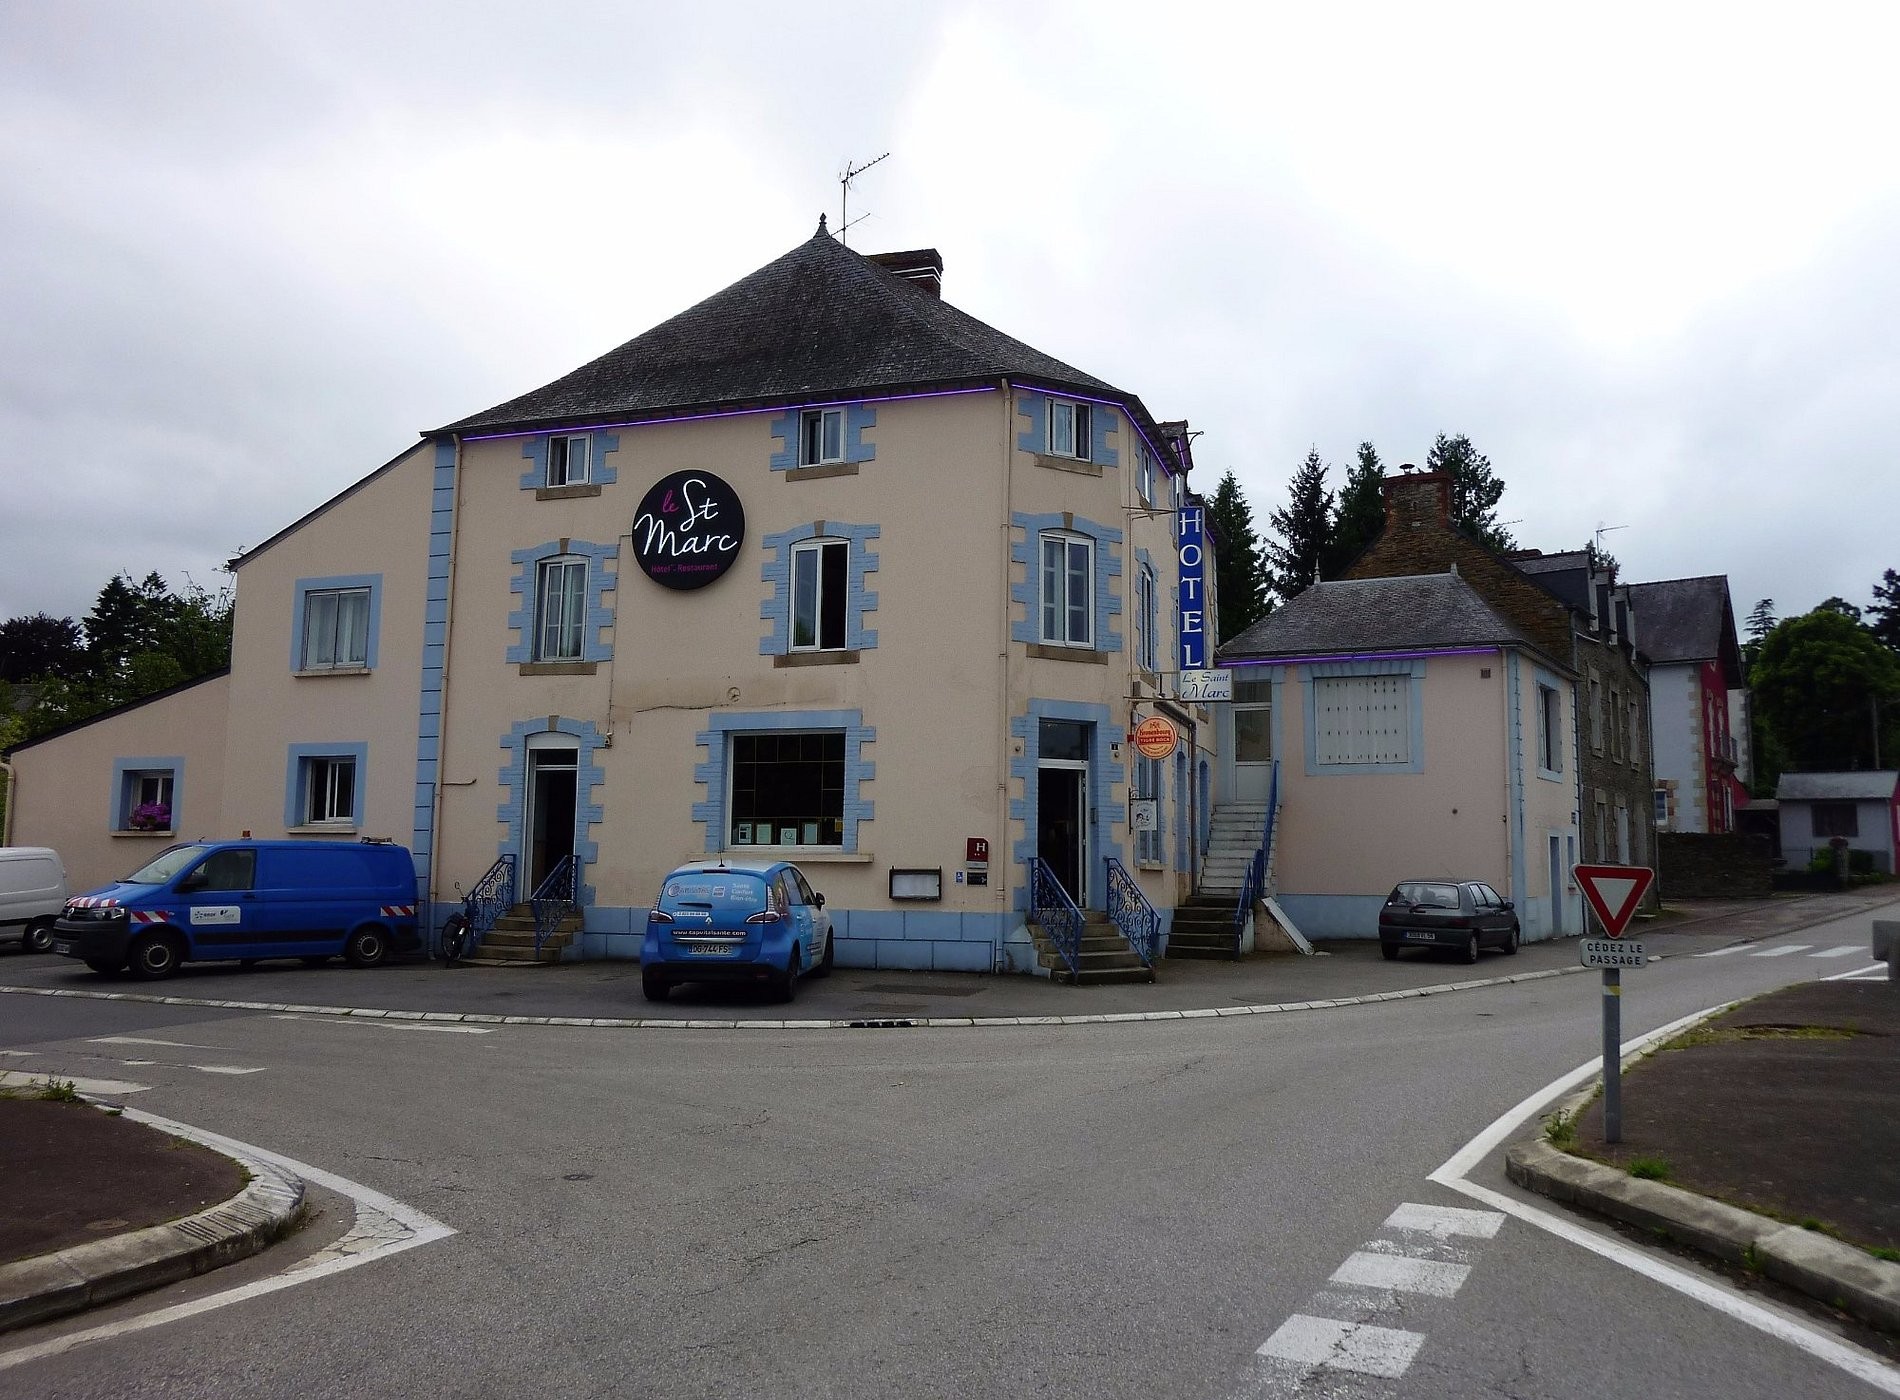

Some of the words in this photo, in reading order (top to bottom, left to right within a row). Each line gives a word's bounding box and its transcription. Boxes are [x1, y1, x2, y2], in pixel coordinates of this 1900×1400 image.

[662, 489, 681, 513] le
[680, 478, 718, 532] St
[634, 513, 738, 557] Marc
[1179, 509, 1203, 667] HOTEL
[1182, 672, 1197, 683] Le
[1200, 671, 1229, 682] Saint
[1182, 683, 1230, 698] Marc
[976, 843, 986, 852] H
[1587, 941, 1624, 953] CÉDEZ
[1629, 944, 1643, 953] LE
[1590, 955, 1641, 965] PASSAGE
